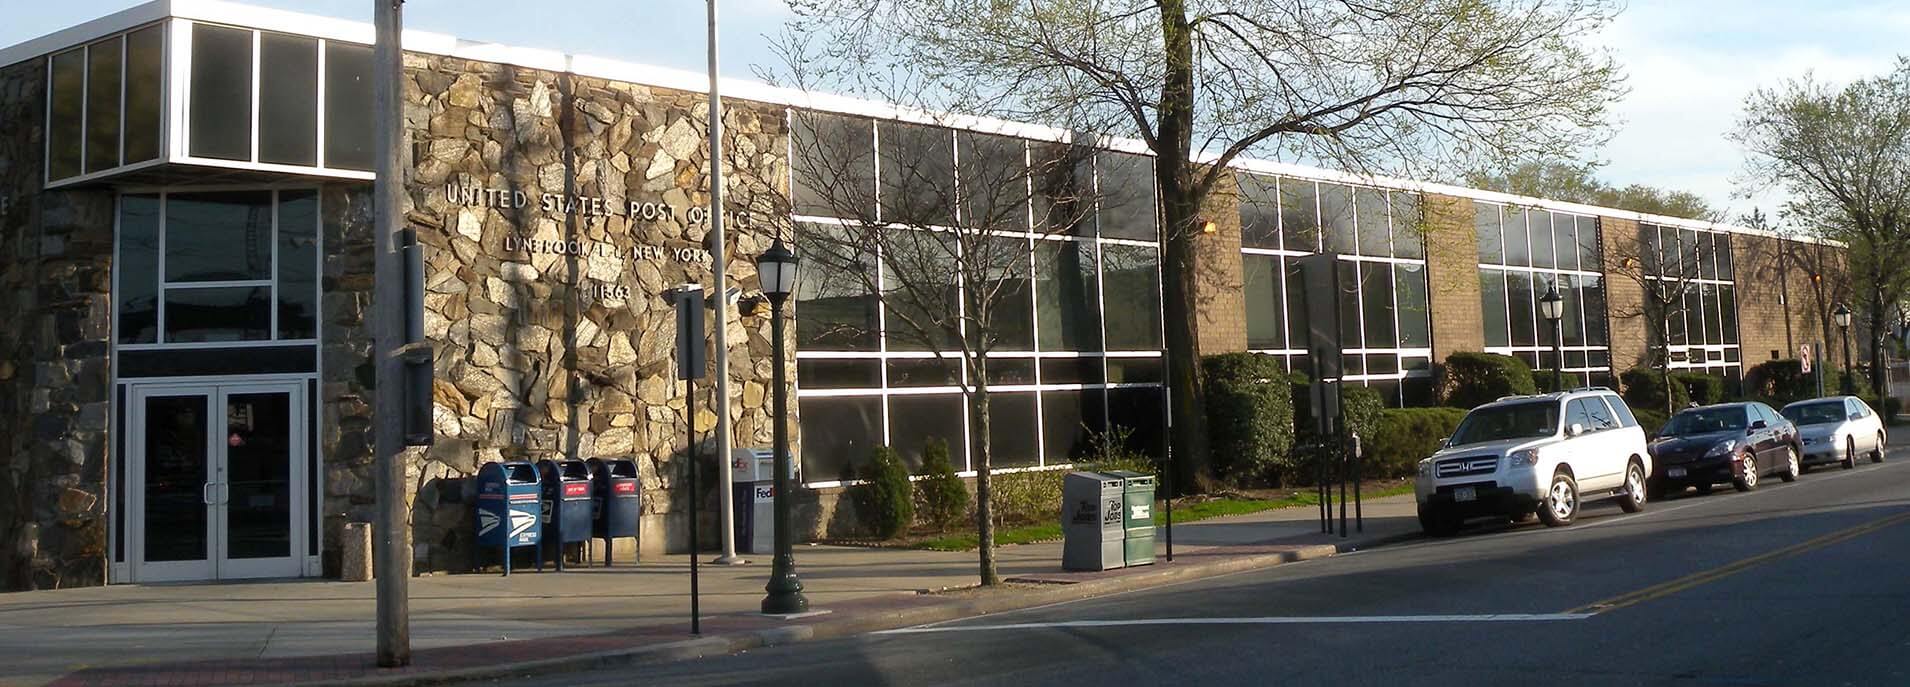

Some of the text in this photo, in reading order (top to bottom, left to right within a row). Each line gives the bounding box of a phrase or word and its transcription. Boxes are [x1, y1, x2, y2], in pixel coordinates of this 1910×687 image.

[446, 183, 527, 209] UNITED
[542, 193, 614, 217] STATES
[630, 201, 678, 222] POST
[633, 246, 665, 260] NEW
[673, 247, 710, 263] YORK
[593, 285, 631, 299] 11563
